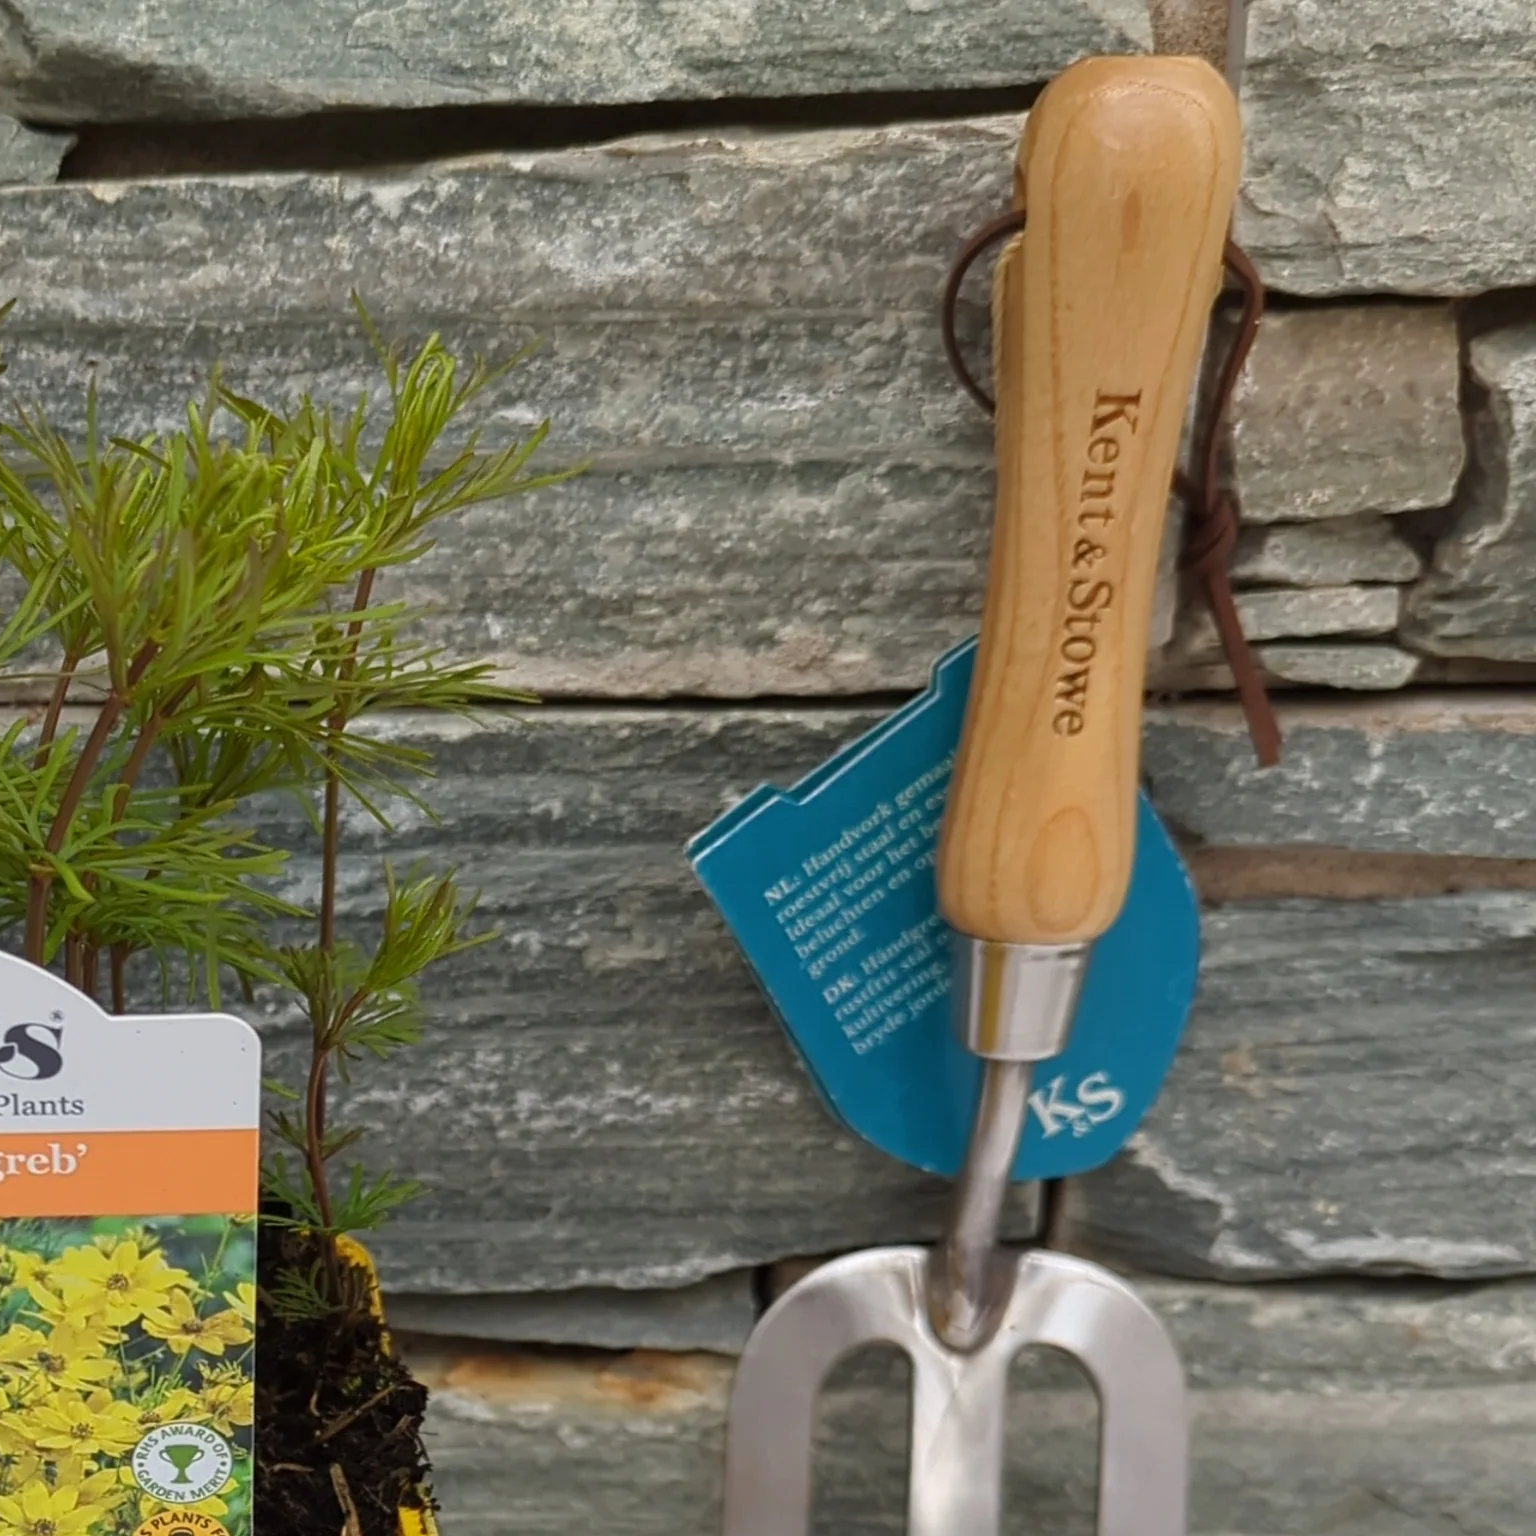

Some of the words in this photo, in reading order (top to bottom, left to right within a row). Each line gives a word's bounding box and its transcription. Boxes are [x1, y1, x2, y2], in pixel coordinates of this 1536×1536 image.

[1077, 388, 1143, 529] Kent
[1071, 538, 1107, 570] &
[1052, 577, 1114, 738] Stowe
[802, 803, 893, 877] Handvork
[854, 824, 896, 862] staal
[898, 808, 922, 830] en
[843, 860, 885, 896] voor
[886, 836, 919, 865] het
[794, 889, 885, 958] beluchten
[888, 868, 911, 890] en
[136, 1435, 159, 1461] RHS
[160, 1425, 215, 1445] AWARD
[212, 1442, 230, 1461] OF
[137, 1469, 186, 1501] GARDEN
[190, 1467, 228, 1500] MERIT
[151, 1511, 212, 1532] PLANTS
